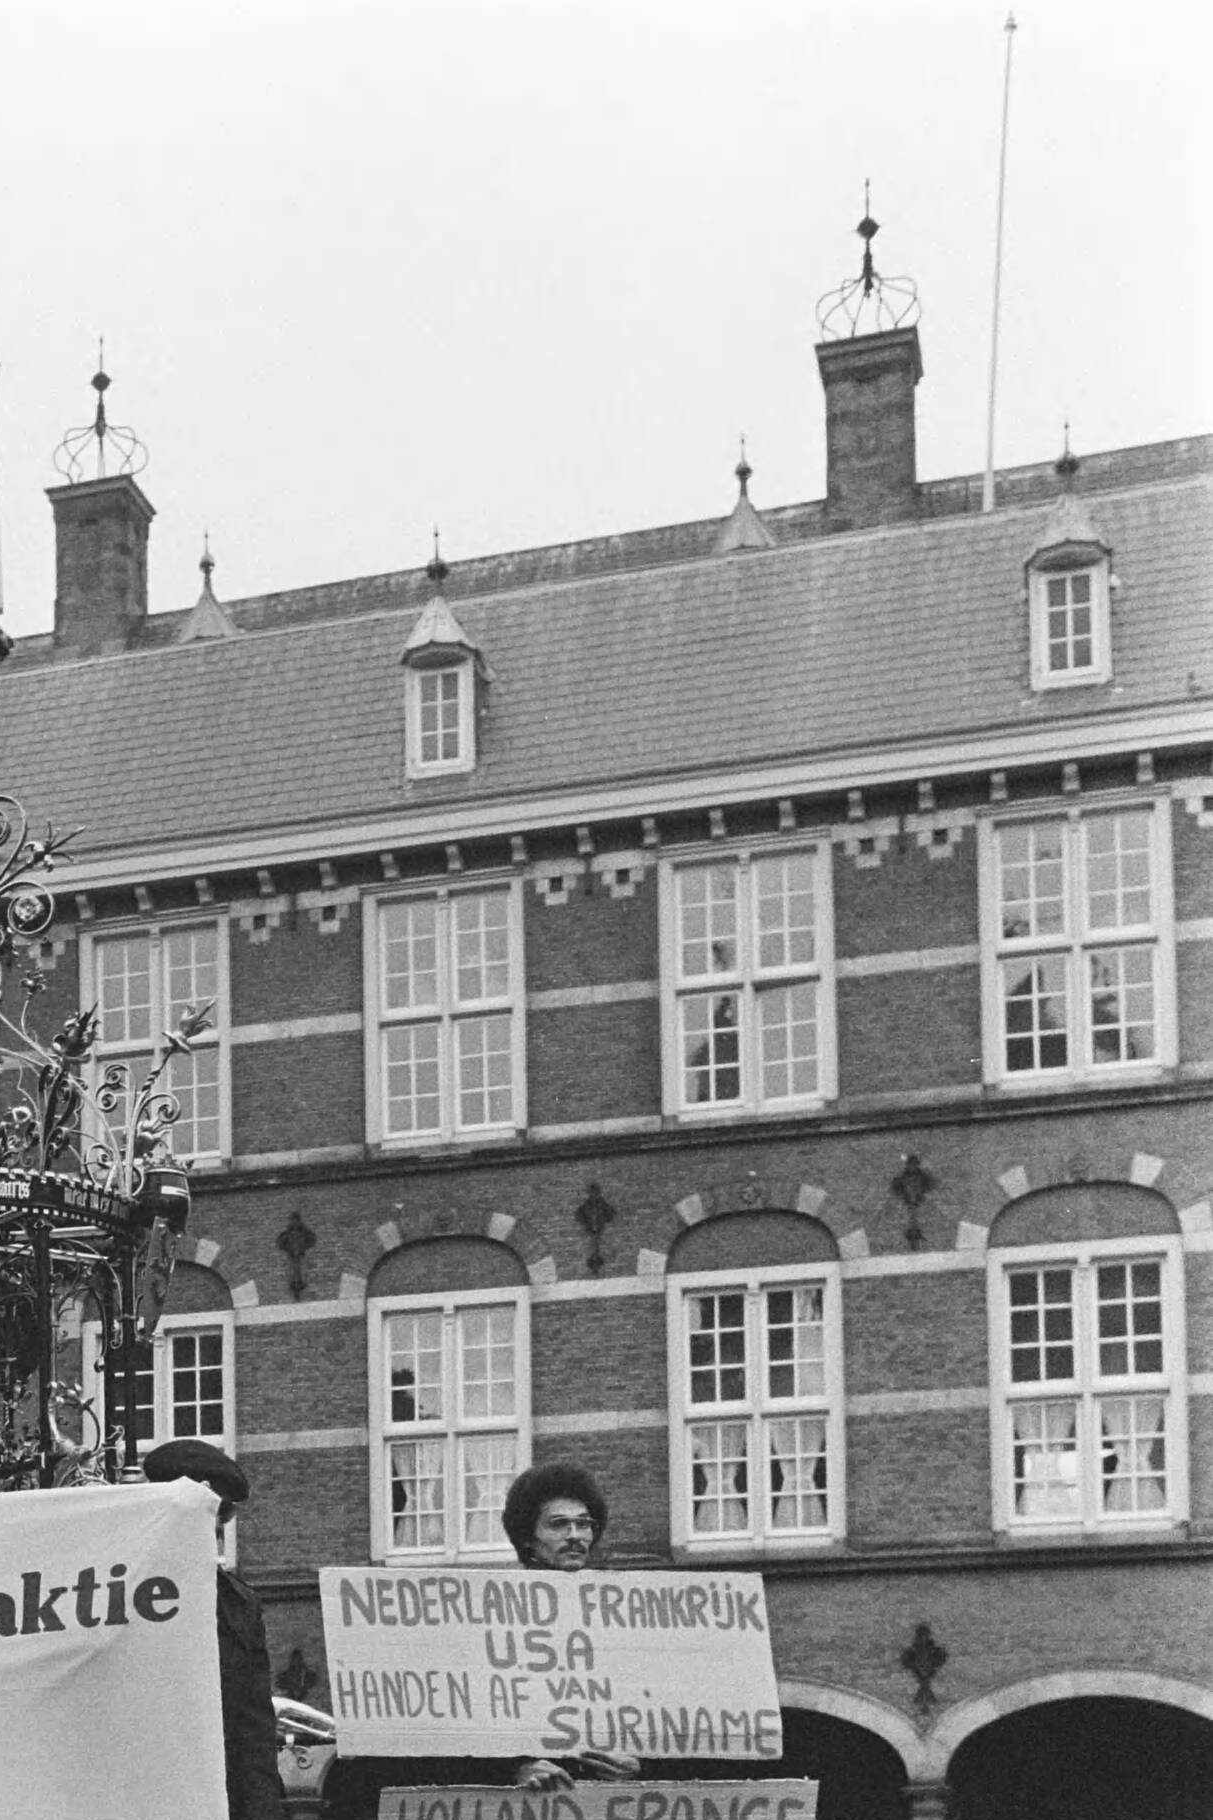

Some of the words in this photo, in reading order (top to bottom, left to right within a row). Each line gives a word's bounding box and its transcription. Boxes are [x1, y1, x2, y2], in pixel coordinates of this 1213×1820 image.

[339, 1576, 559, 1627] NEDERLAND
[336, 1669, 473, 1719] HANDEN
[490, 1674, 530, 1719] AF
[545, 1676, 612, 1701] VAN
